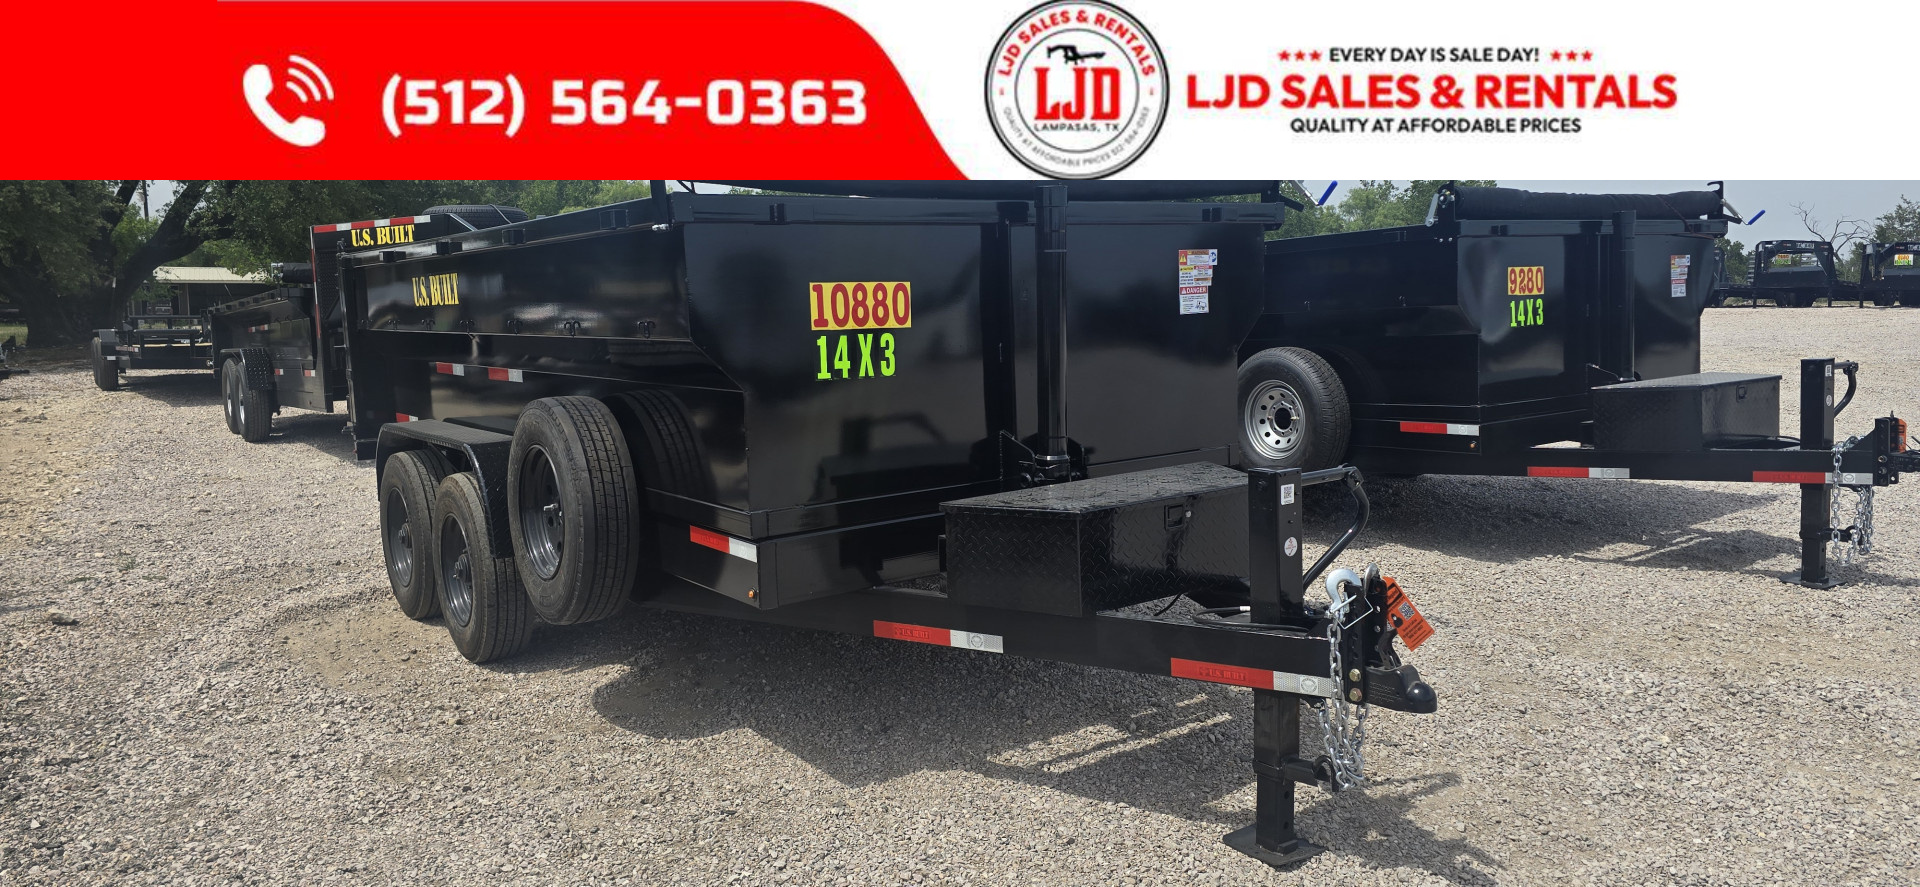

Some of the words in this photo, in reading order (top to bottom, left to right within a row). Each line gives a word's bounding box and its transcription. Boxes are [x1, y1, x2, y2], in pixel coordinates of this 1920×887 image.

[351, 229, 374, 247] U.S.
[376, 224, 415, 245] BUILT
[412, 276, 429, 307] U.S.
[429, 273, 459, 306] BUILT
[1509, 267, 1544, 294] 9280
[812, 283, 910, 328] 10880
